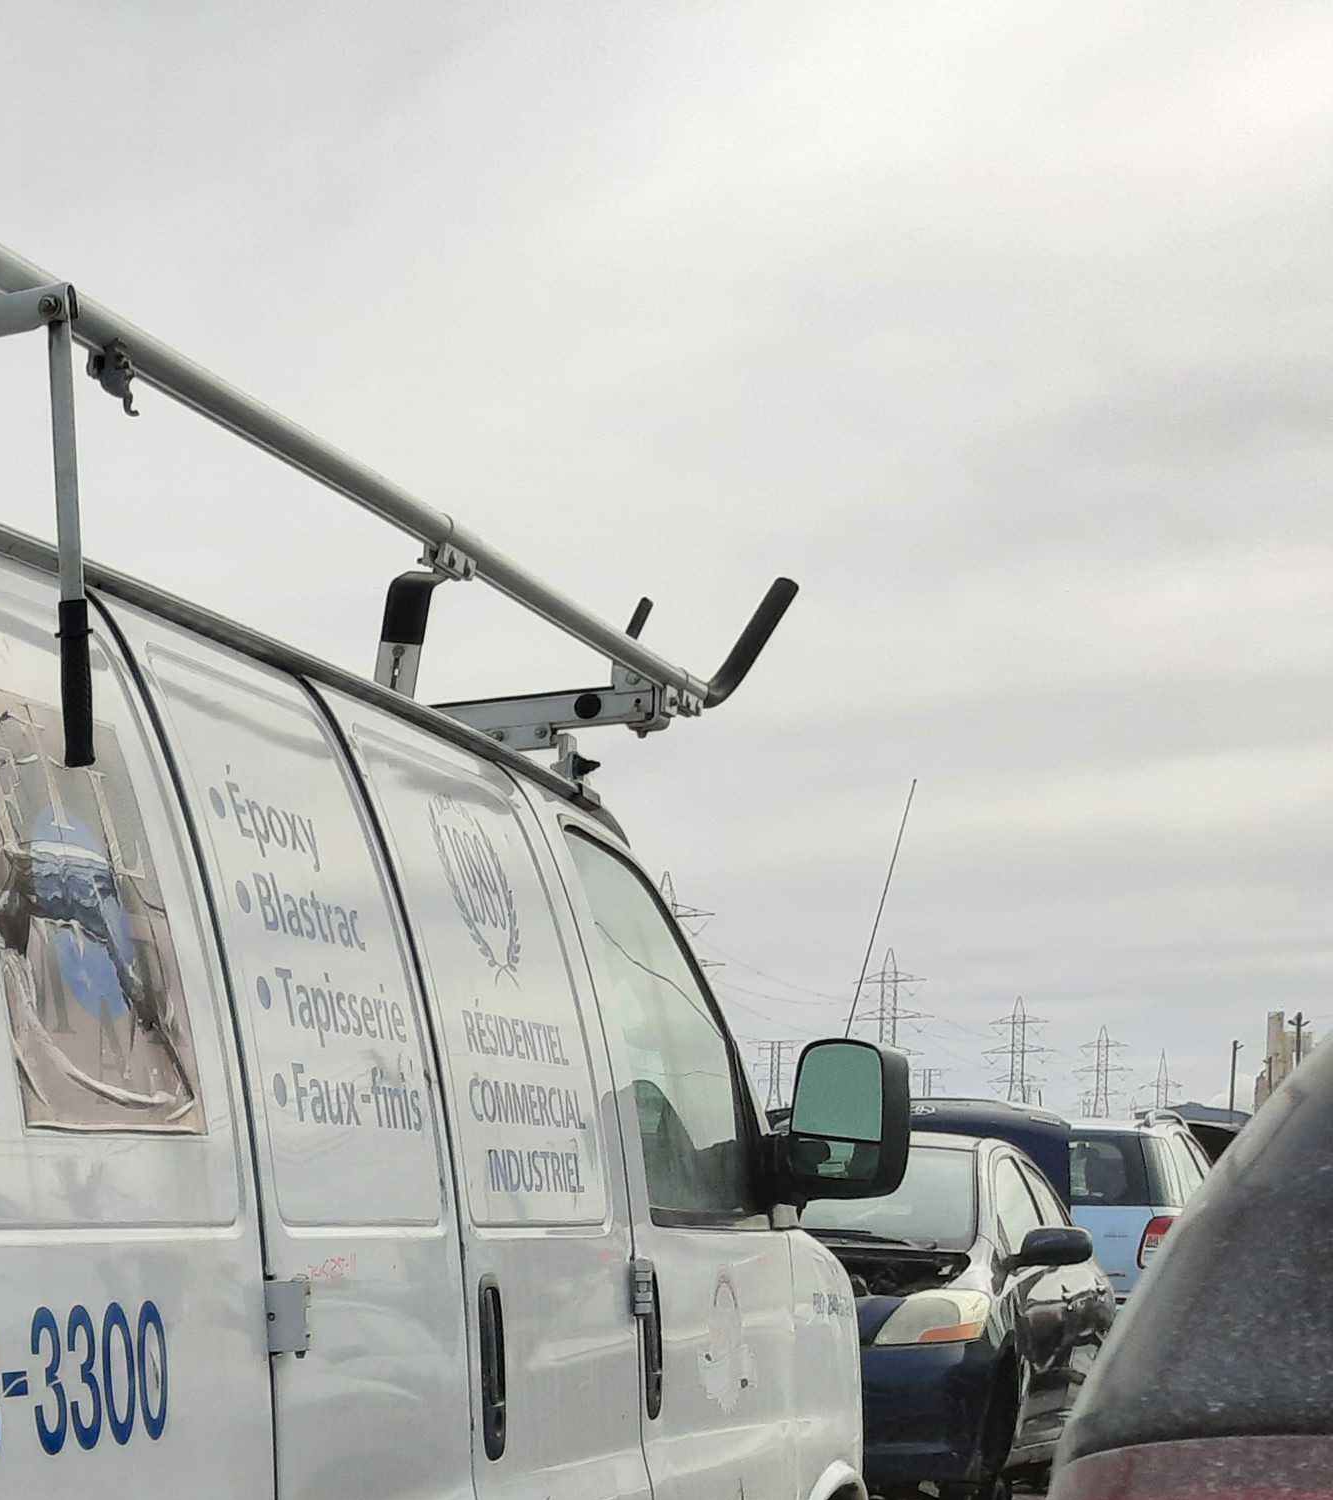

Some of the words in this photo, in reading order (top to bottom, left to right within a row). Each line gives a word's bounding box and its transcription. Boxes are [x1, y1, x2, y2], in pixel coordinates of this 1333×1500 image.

[225, 766, 321, 872] Époxy
[253, 871, 367, 952] Blastrac
[275, 968, 408, 1048] Tapisserie
[462, 998, 570, 1066] RÉSIDENTIEL
[291, 1062, 423, 1132] Faux-finis
[469, 1077, 587, 1130] COMMERCIAL
[488, 1148, 586, 1194] INDUSTRIEL
